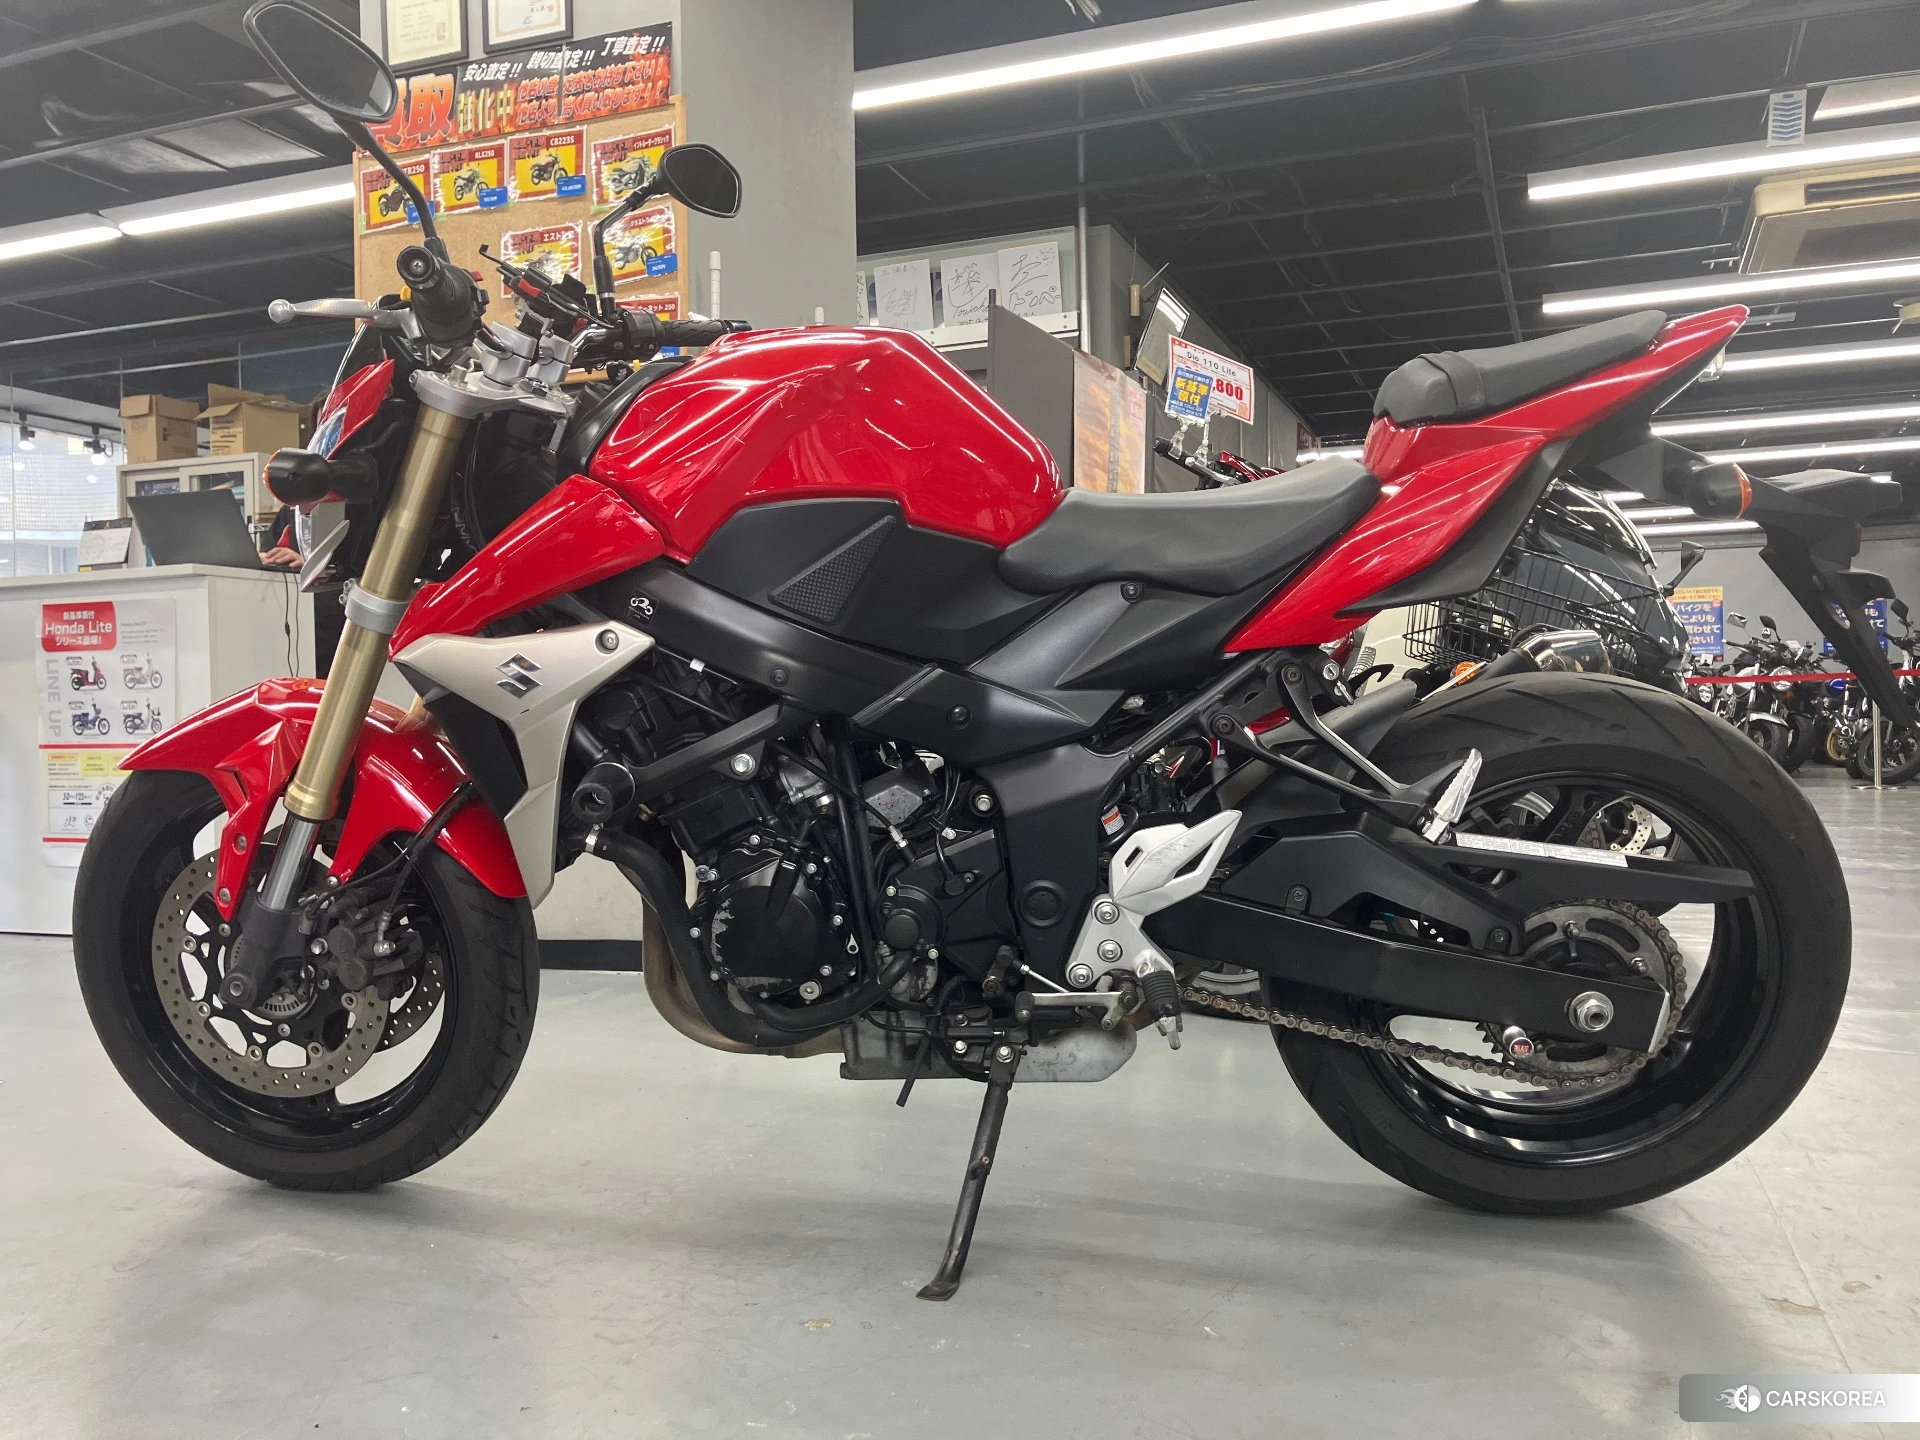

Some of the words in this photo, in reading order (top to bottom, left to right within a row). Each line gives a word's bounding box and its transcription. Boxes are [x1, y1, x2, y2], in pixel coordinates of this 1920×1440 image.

[457, 83, 516, 134] 強化中
[550, 135, 575, 146] CB223S
[403, 164, 425, 175] TR250
[664, 303, 676, 311] 250
[1187, 351, 1199, 362] Dio
[1203, 358, 1219, 370] 110
[1221, 365, 1237, 377] Lite
[1212, 378, 1244, 401] ,800
[45, 622, 84, 635] Honda
[88, 620, 113, 634] Lite
[46, 658, 60, 703] LINE
[48, 710, 62, 737] UP
